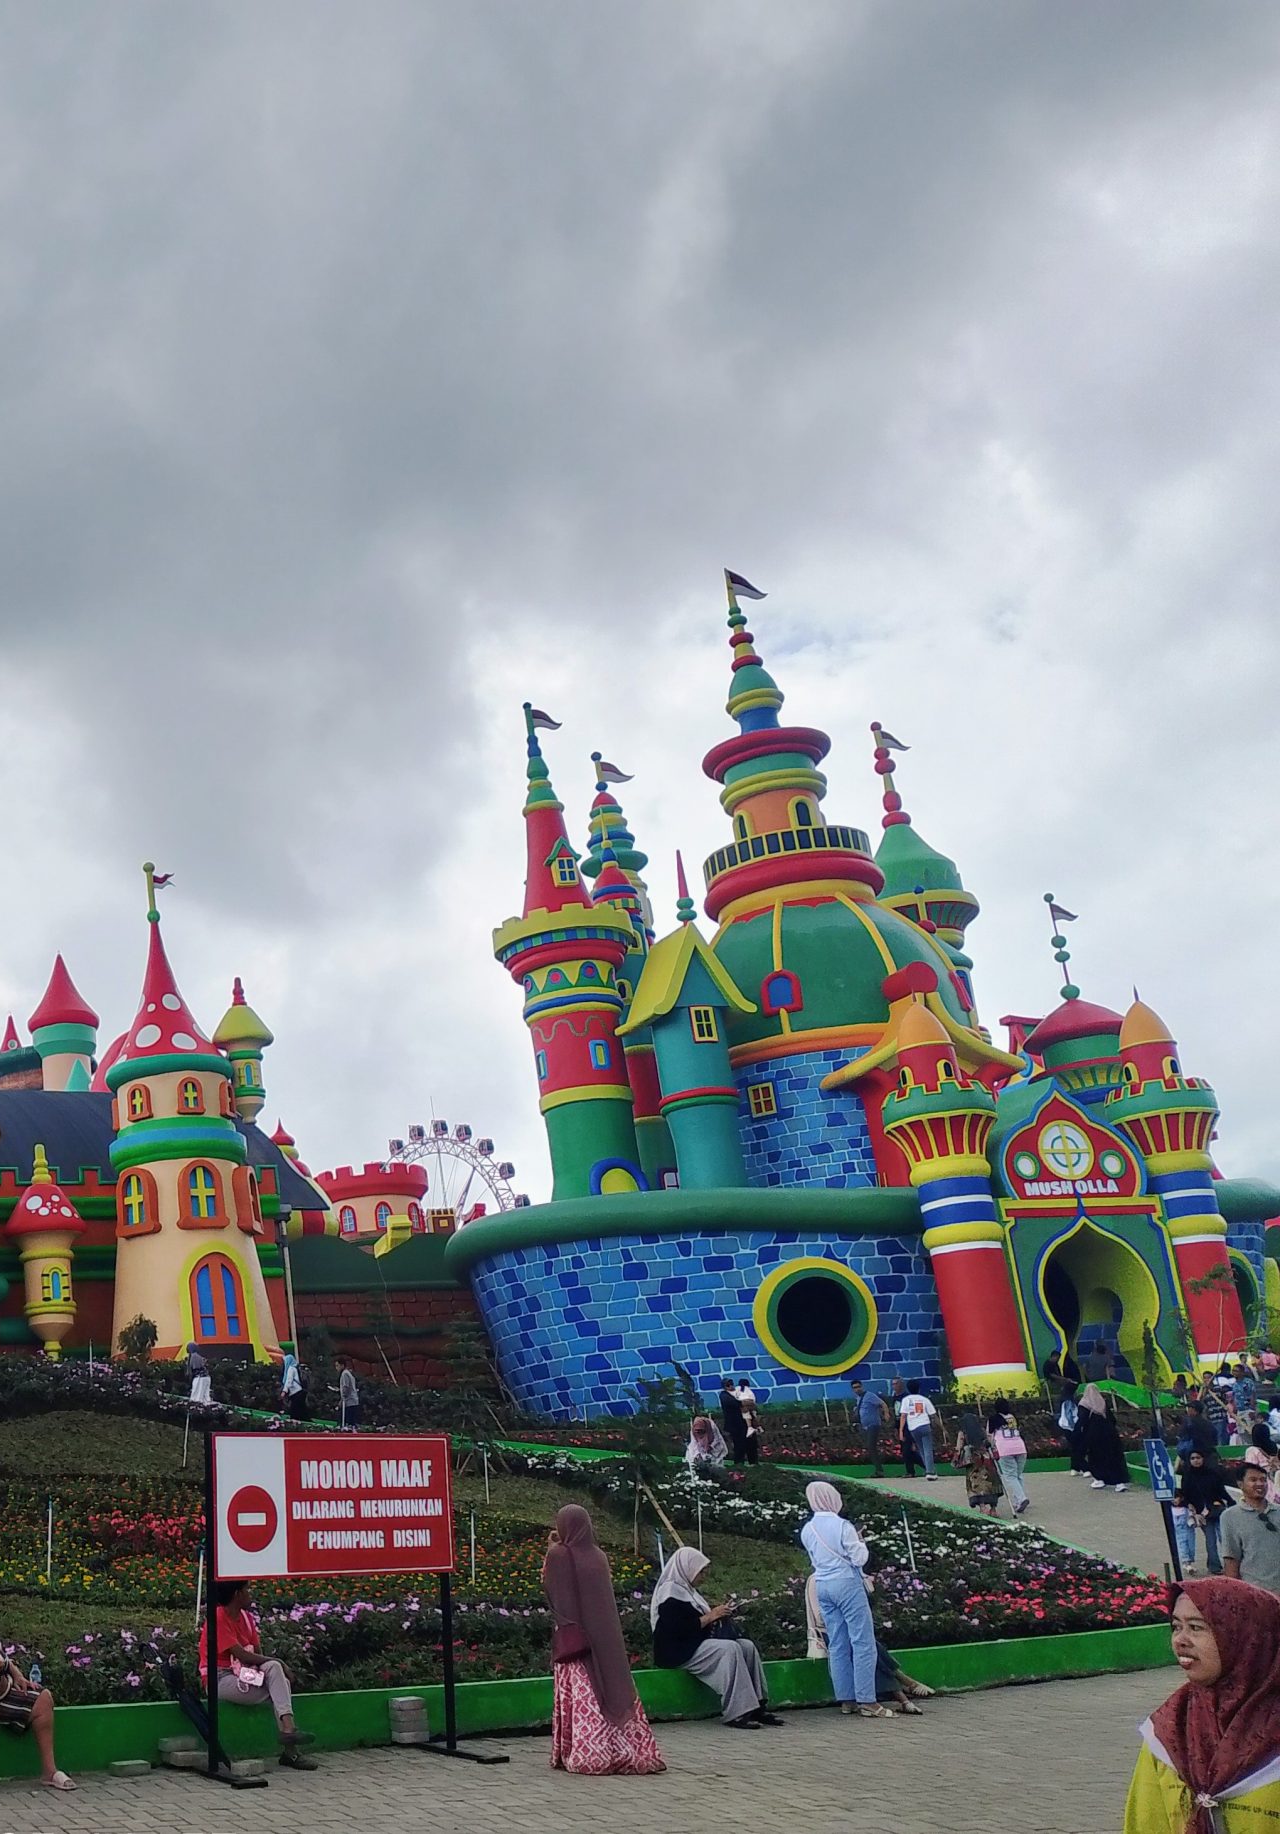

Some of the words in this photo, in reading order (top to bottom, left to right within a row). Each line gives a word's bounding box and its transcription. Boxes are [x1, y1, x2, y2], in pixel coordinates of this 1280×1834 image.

[1024, 1179, 1119, 1196] MUSHOLLA
[300, 1459, 373, 1489] MOHON
[380, 1459, 432, 1488] MAAF
[292, 1500, 355, 1520] DILARANG
[360, 1498, 443, 1518] MENURUNKAN
[308, 1530, 385, 1550] PENUMPANG
[393, 1529, 431, 1548] DISINI
